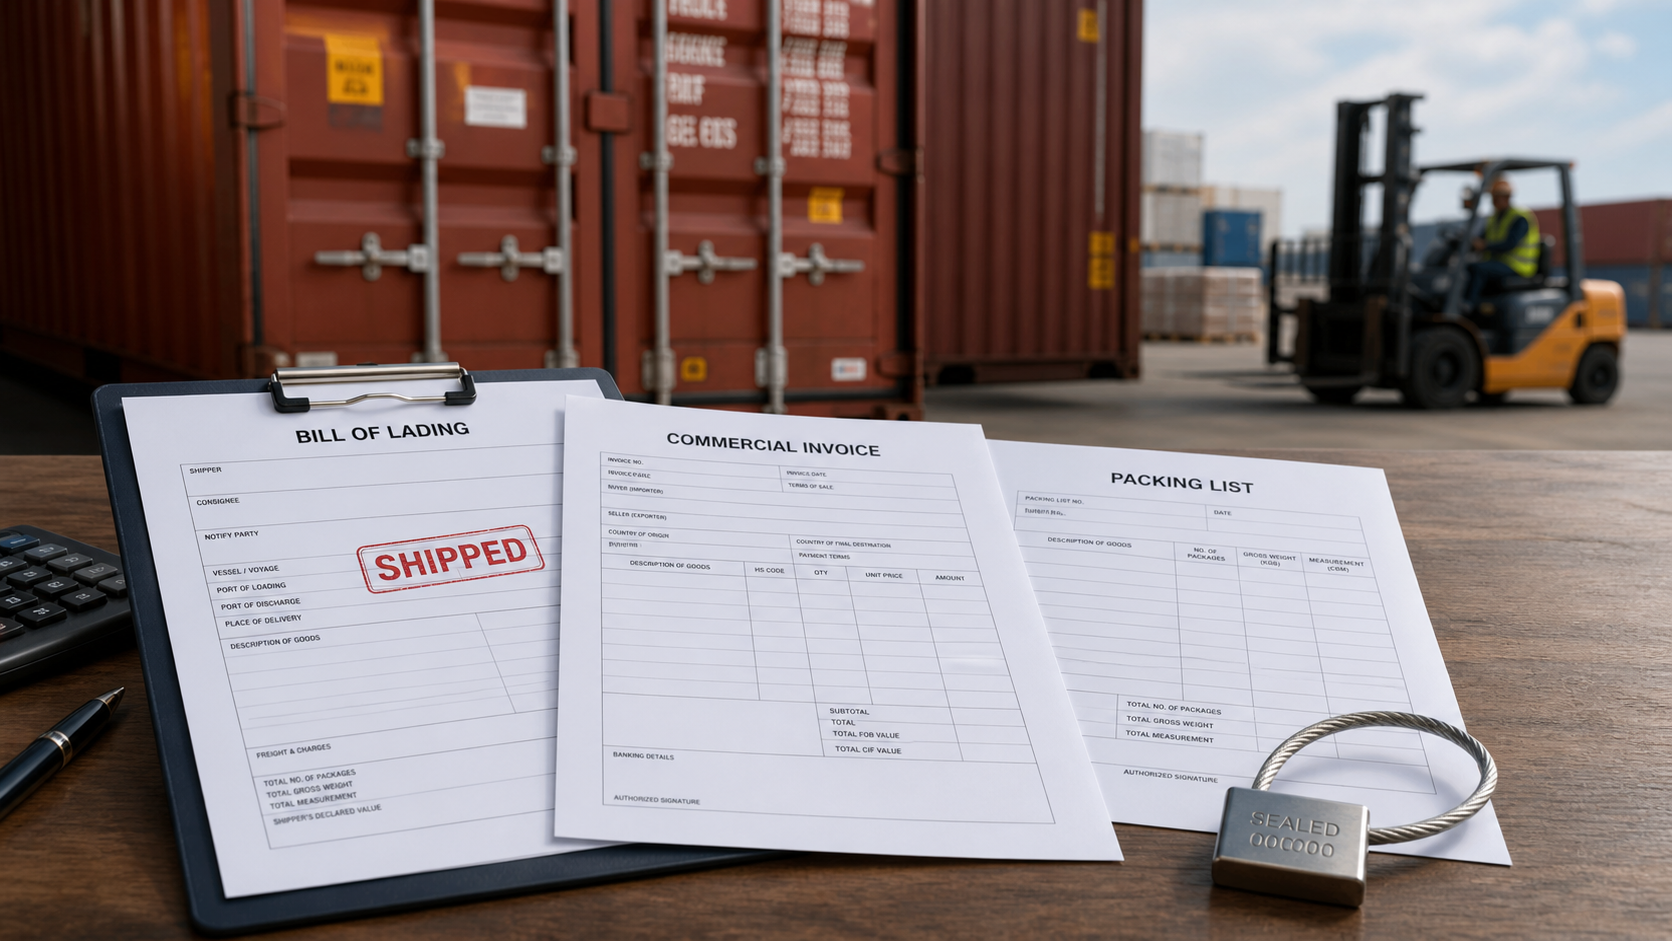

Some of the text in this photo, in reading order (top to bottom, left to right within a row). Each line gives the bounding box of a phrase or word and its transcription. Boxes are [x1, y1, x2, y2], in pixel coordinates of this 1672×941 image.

[296, 421, 470, 444] BILL OF LADING
[667, 432, 881, 457] COMMERCIAL INVOICE
[189, 466, 222, 475] SHIPPER
[1111, 472, 1254, 494] PACKING LIST
[196, 497, 240, 506] CONSIGNEE
[1213, 509, 1232, 517] DATE
[204, 530, 259, 541] NOTIFY PARTY
[1106, 541, 1132, 549] GOODS
[373, 538, 527, 581] SHIPPED
[1187, 553, 1226, 561] PACKAGES
[1269, 554, 1297, 562] WEIGHT
[212, 568, 242, 577] VESSEL
[248, 564, 280, 574] VOYAGE
[630, 560, 674, 568] DESCRIPTION
[754, 566, 765, 574] HS
[935, 574, 965, 582] AMOUNT
[216, 581, 287, 594] PORT OF LOADING
[220, 597, 301, 611] PORT OF DISCHARGE
[225, 614, 302, 627] PLACE OF DELIVERY
[230, 634, 321, 650] DESCRIPTION OF GOODS
[829, 707, 870, 716] SUBTOTAL
[1127, 700, 1151, 709] TOTAL
[1152, 703, 1167, 711] NO.
[1180, 705, 1222, 716] PACKAGES
[831, 718, 856, 727] TOTAL
[1126, 715, 1214, 729] TOTAL GROSS WEIGHT
[833, 730, 857, 738] TOTAL
[1125, 729, 1214, 744] TOTAL MEASUREMENT
[256, 748, 288, 759] FREIGHT
[296, 743, 332, 754] CHARGES
[612, 751, 675, 761] BANKING DETAILS
[835, 745, 902, 755] TOTAL CIF VALUE
[263, 768, 357, 787] TOTAL NO. OF PACKAGES
[1123, 768, 1219, 784] AUTHORIZED SIGNATURE
[266, 780, 353, 799] TOTAL GROSS WEIGHT
[269, 791, 357, 810] TOTAL MEASUREMENT
[613, 795, 701, 805] AUTHORIZED SIGNATURE
[273, 803, 382, 826] SHIPPER'S DECLARED VALUE
[1250, 811, 1340, 837] SEALED
